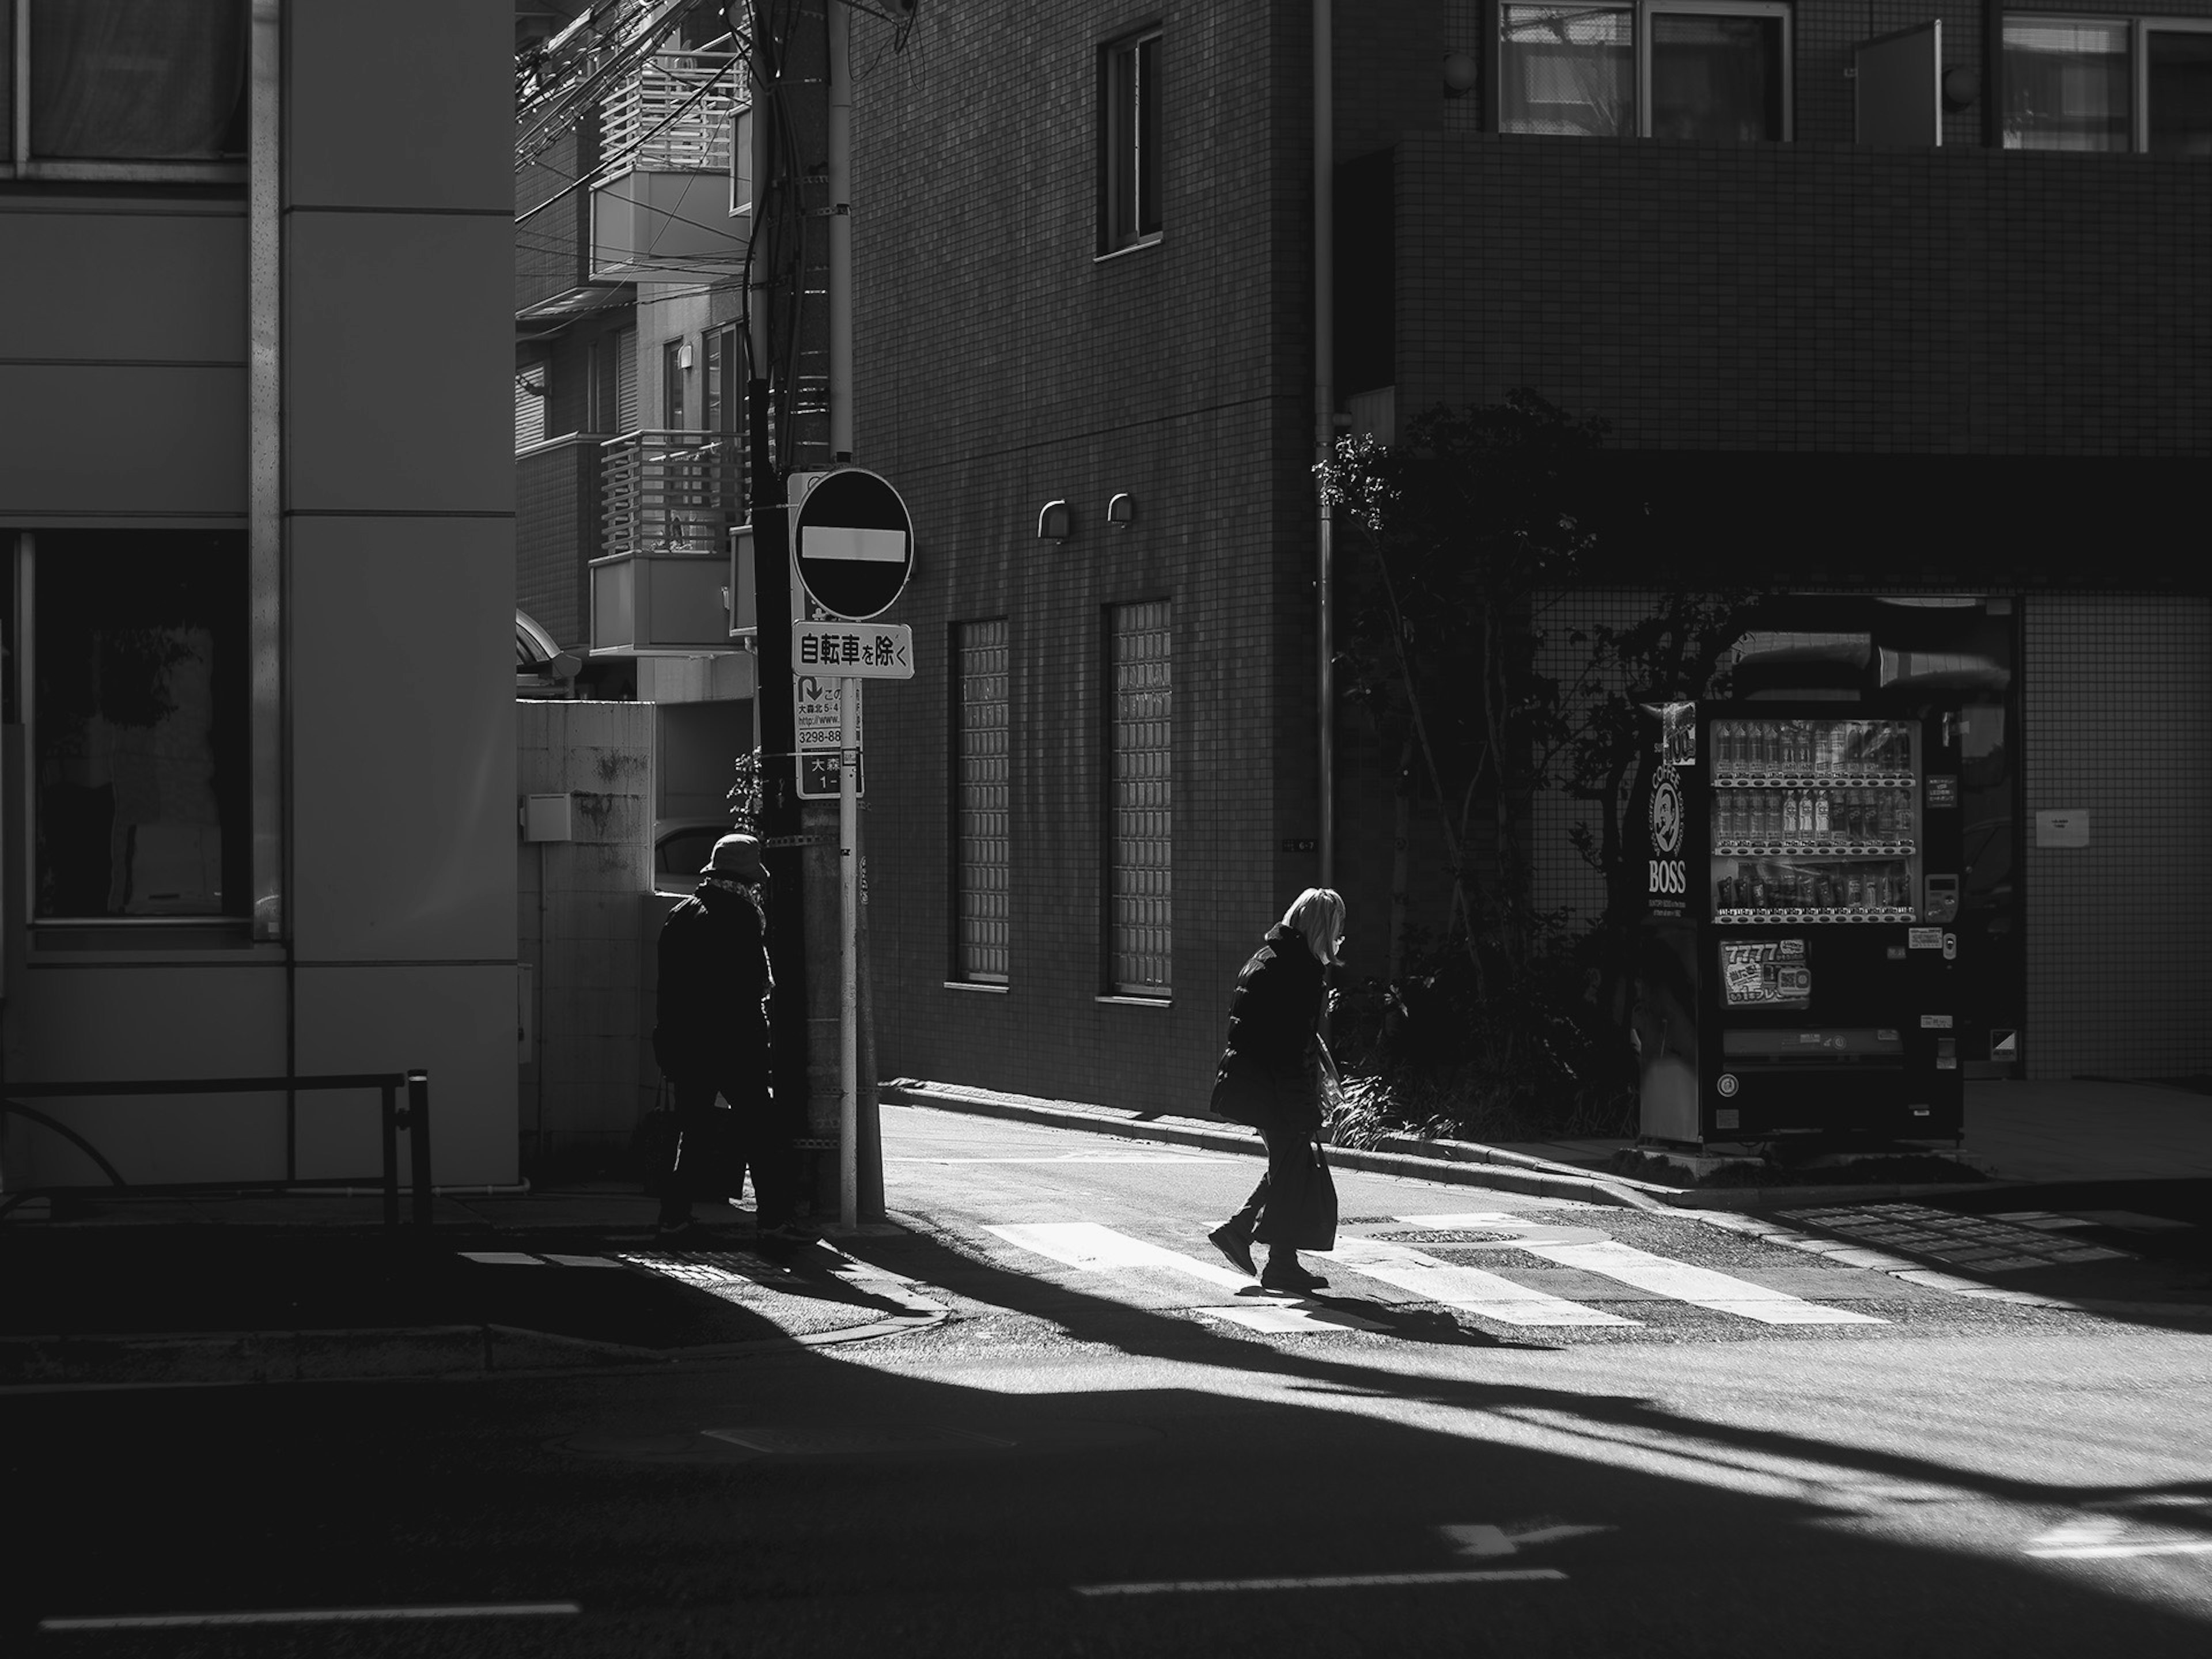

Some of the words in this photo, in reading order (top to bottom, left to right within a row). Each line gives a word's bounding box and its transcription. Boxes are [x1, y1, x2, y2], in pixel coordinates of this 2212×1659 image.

[801, 632, 907, 667] 自転車を除く
[799, 730, 841, 743] 3298-88
[1649, 859, 1686, 894] BOSS
[1725, 943, 1778, 964] 7777
